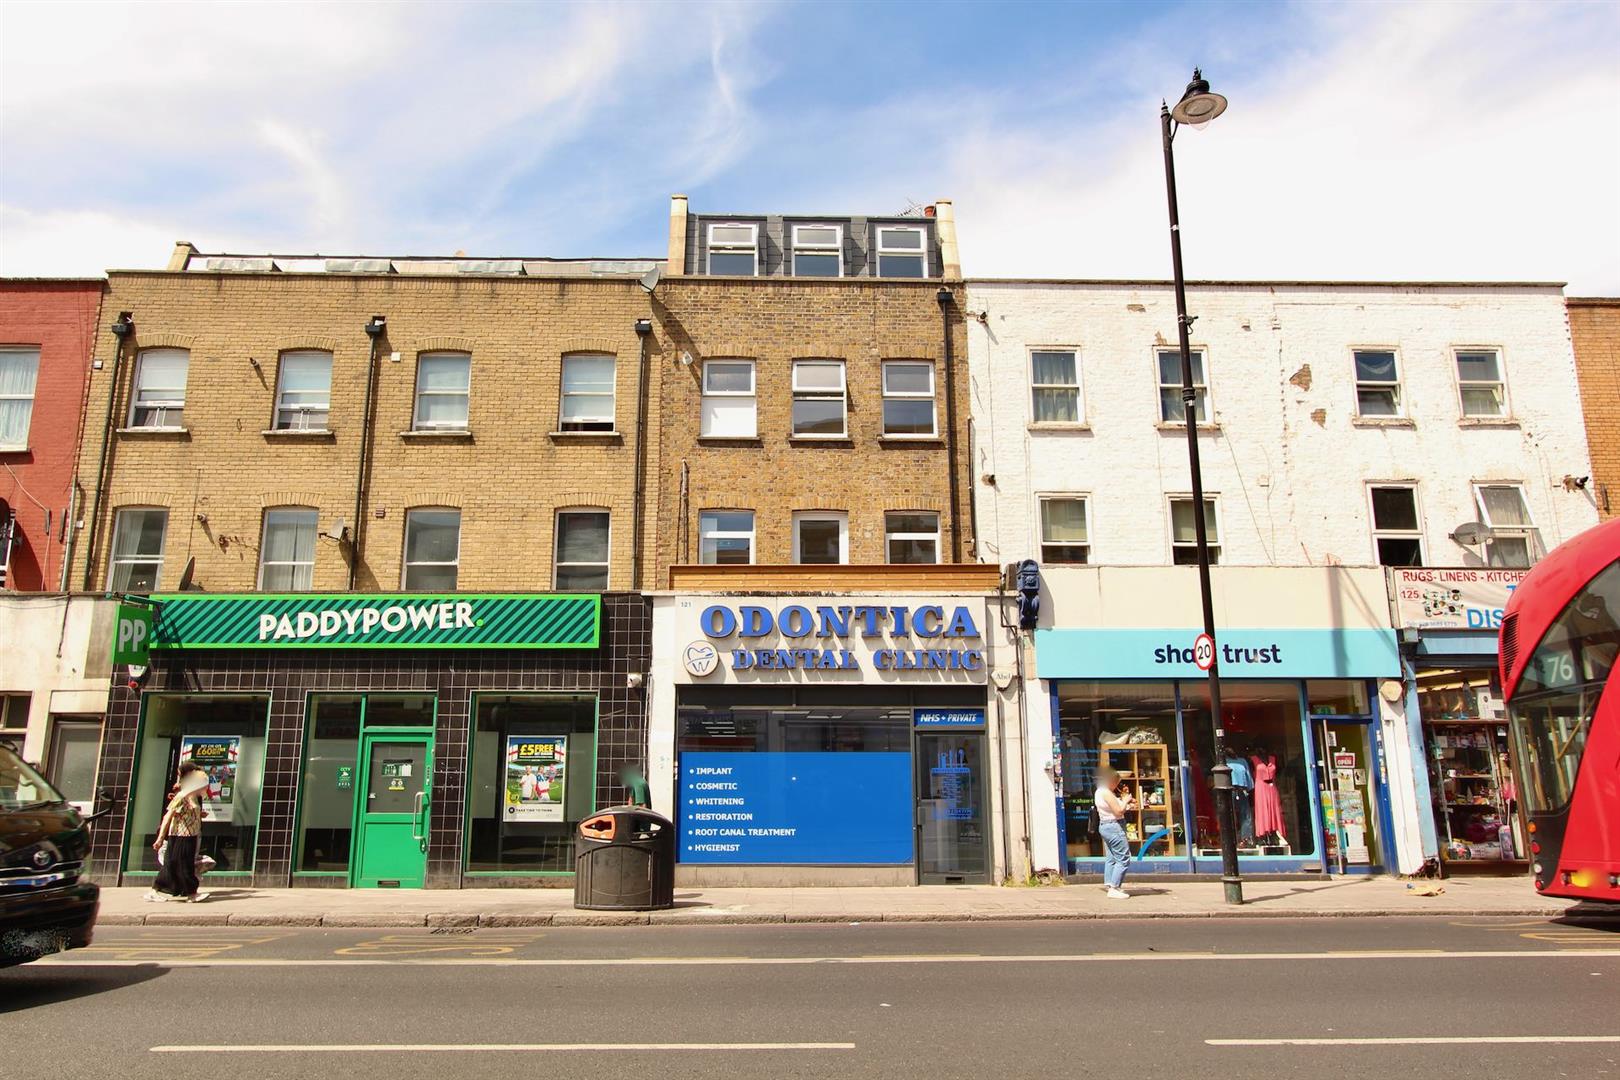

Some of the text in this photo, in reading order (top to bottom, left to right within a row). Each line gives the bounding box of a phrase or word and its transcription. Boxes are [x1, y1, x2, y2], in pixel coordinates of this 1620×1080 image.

[1440, 571, 1478, 582] LINENS
[1486, 571, 1527, 583] KITCHE
[1401, 590, 1420, 599] 125
[700, 604, 981, 638] ODONTICA
[1154, 643, 1283, 664] sha trust
[1197, 643, 1211, 660] 20
[731, 648, 982, 672] DENTAL CLINIC
[1546, 654, 1574, 683] 76
[920, 714, 940, 722] NHS
[947, 713, 977, 722] PRIVATE
[196, 747, 212, 756] £60
[520, 744, 534, 755] £5
[535, 744, 554, 752] FREE
[696, 767, 733, 775] IMPLANT
[695, 782, 738, 790] COSMETIC
[695, 797, 745, 806] WHITENING
[695, 812, 753, 821] RESTORATION
[695, 828, 797, 836] ROOT CANAL TREATMENT
[694, 844, 741, 852] HYGIENIST
